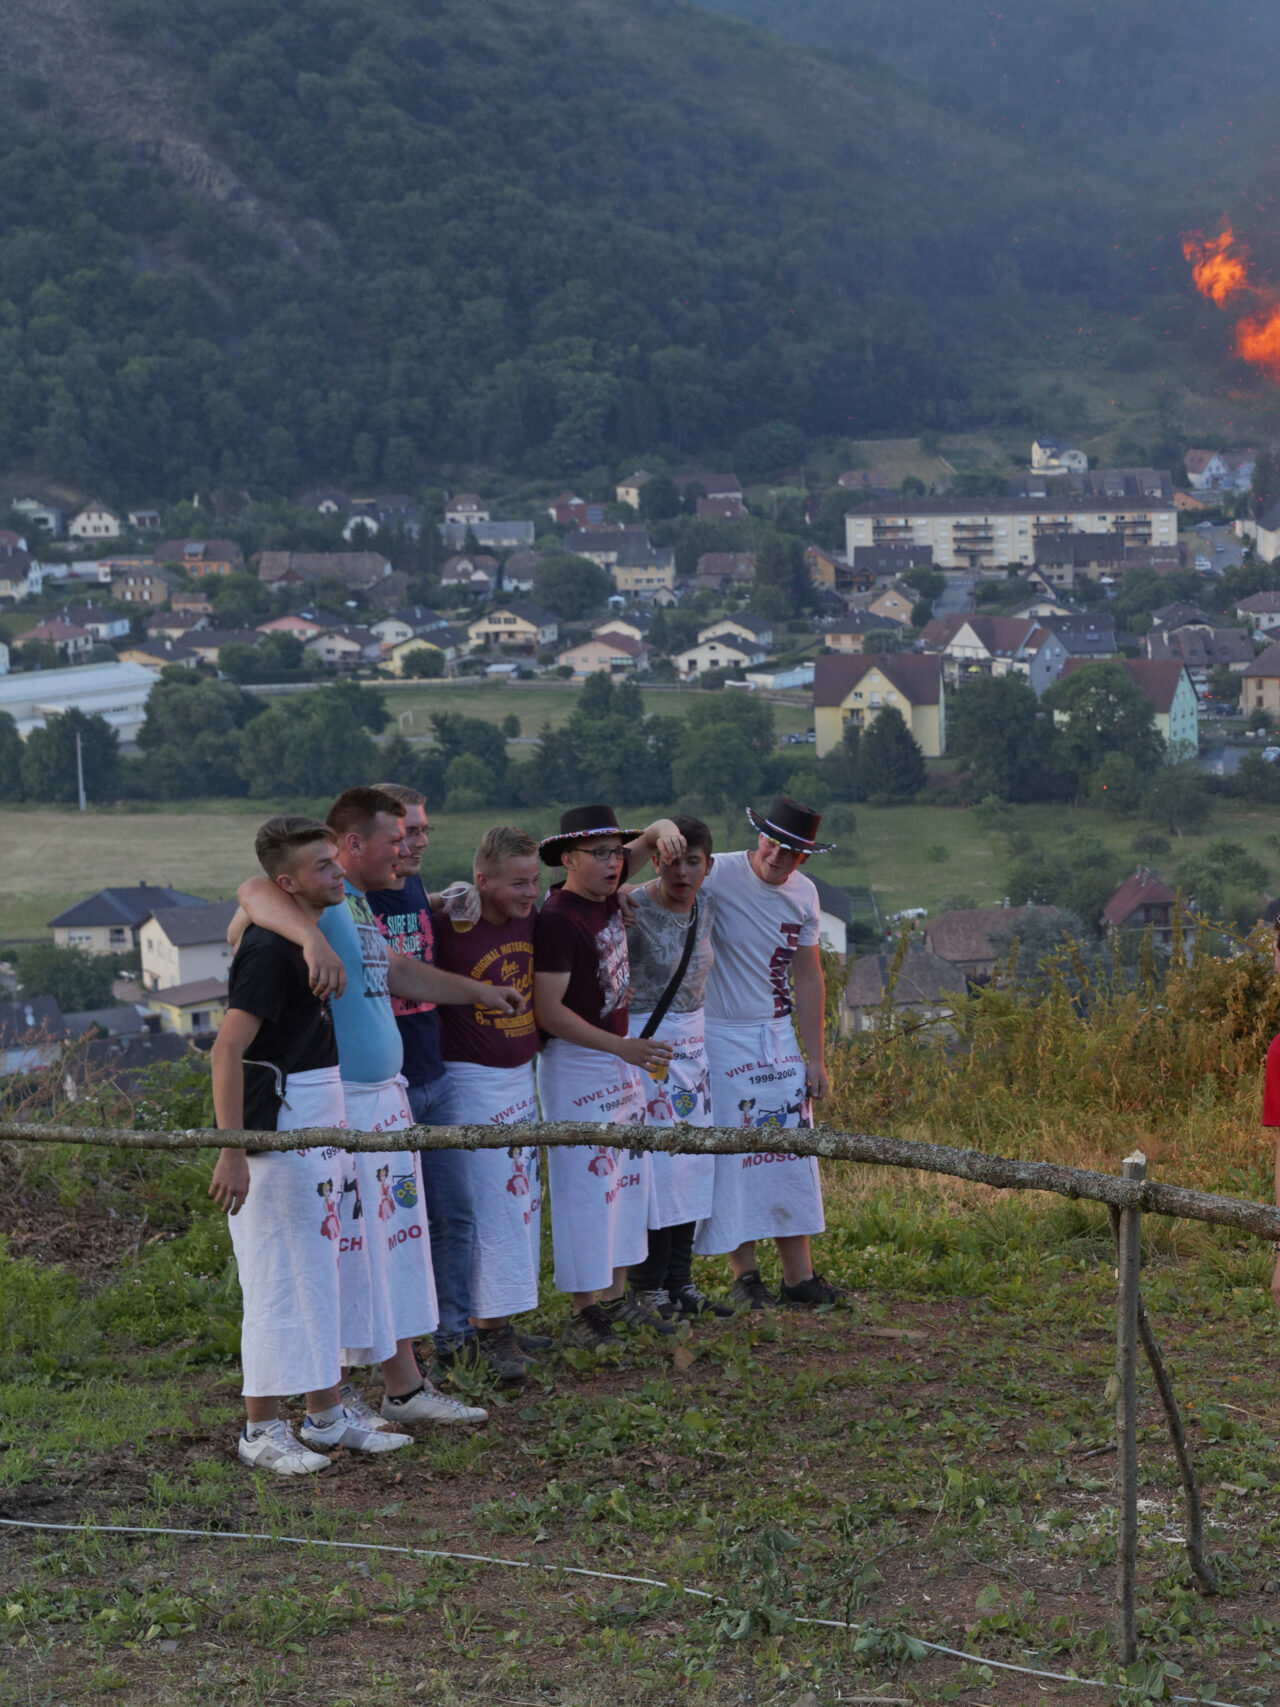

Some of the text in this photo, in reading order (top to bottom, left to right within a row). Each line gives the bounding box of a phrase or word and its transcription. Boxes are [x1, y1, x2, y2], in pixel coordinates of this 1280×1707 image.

[471, 948, 501, 979] ORIGINAL
[725, 1062, 755, 1078] VIVE
[749, 1068, 797, 1085] 1999-2000
[573, 1090, 605, 1107] VIVE
[605, 1084, 620, 1095] LA
[384, 1114, 398, 1127] LA
[490, 1105, 515, 1124] VIVE
[516, 1100, 528, 1111] LA
[742, 1151, 809, 1169] MOOSC
